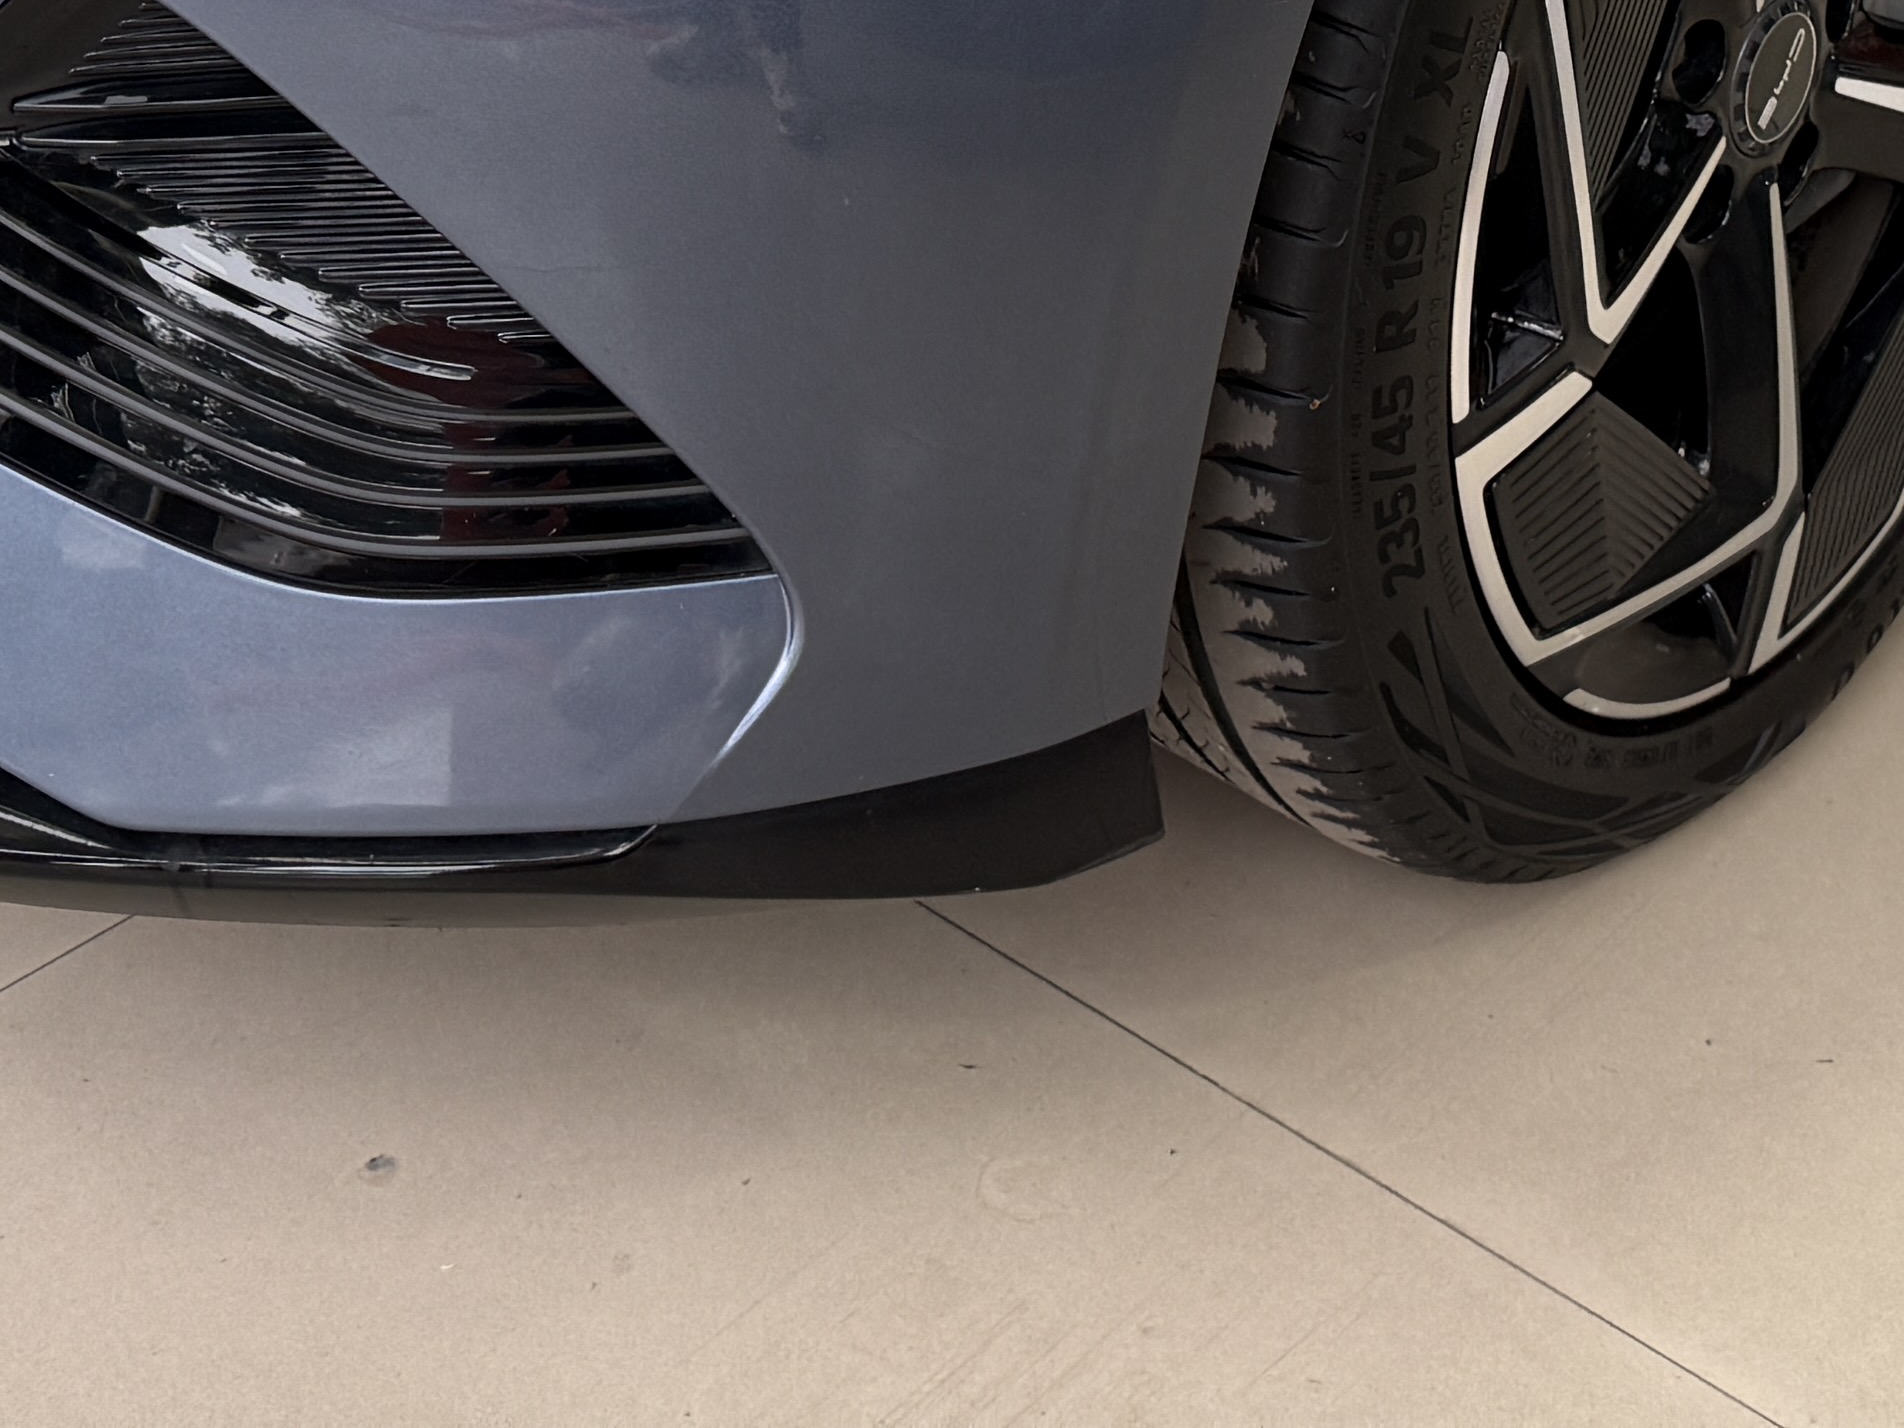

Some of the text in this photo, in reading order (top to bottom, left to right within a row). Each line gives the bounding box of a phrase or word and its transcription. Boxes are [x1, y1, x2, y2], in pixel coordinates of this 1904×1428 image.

[1411, 15, 1474, 109] XL
[1400, 132, 1443, 186] V
[1385, 214, 1430, 293] 19
[1372, 299, 1421, 354] R
[1367, 373, 1427, 600] 235/45
